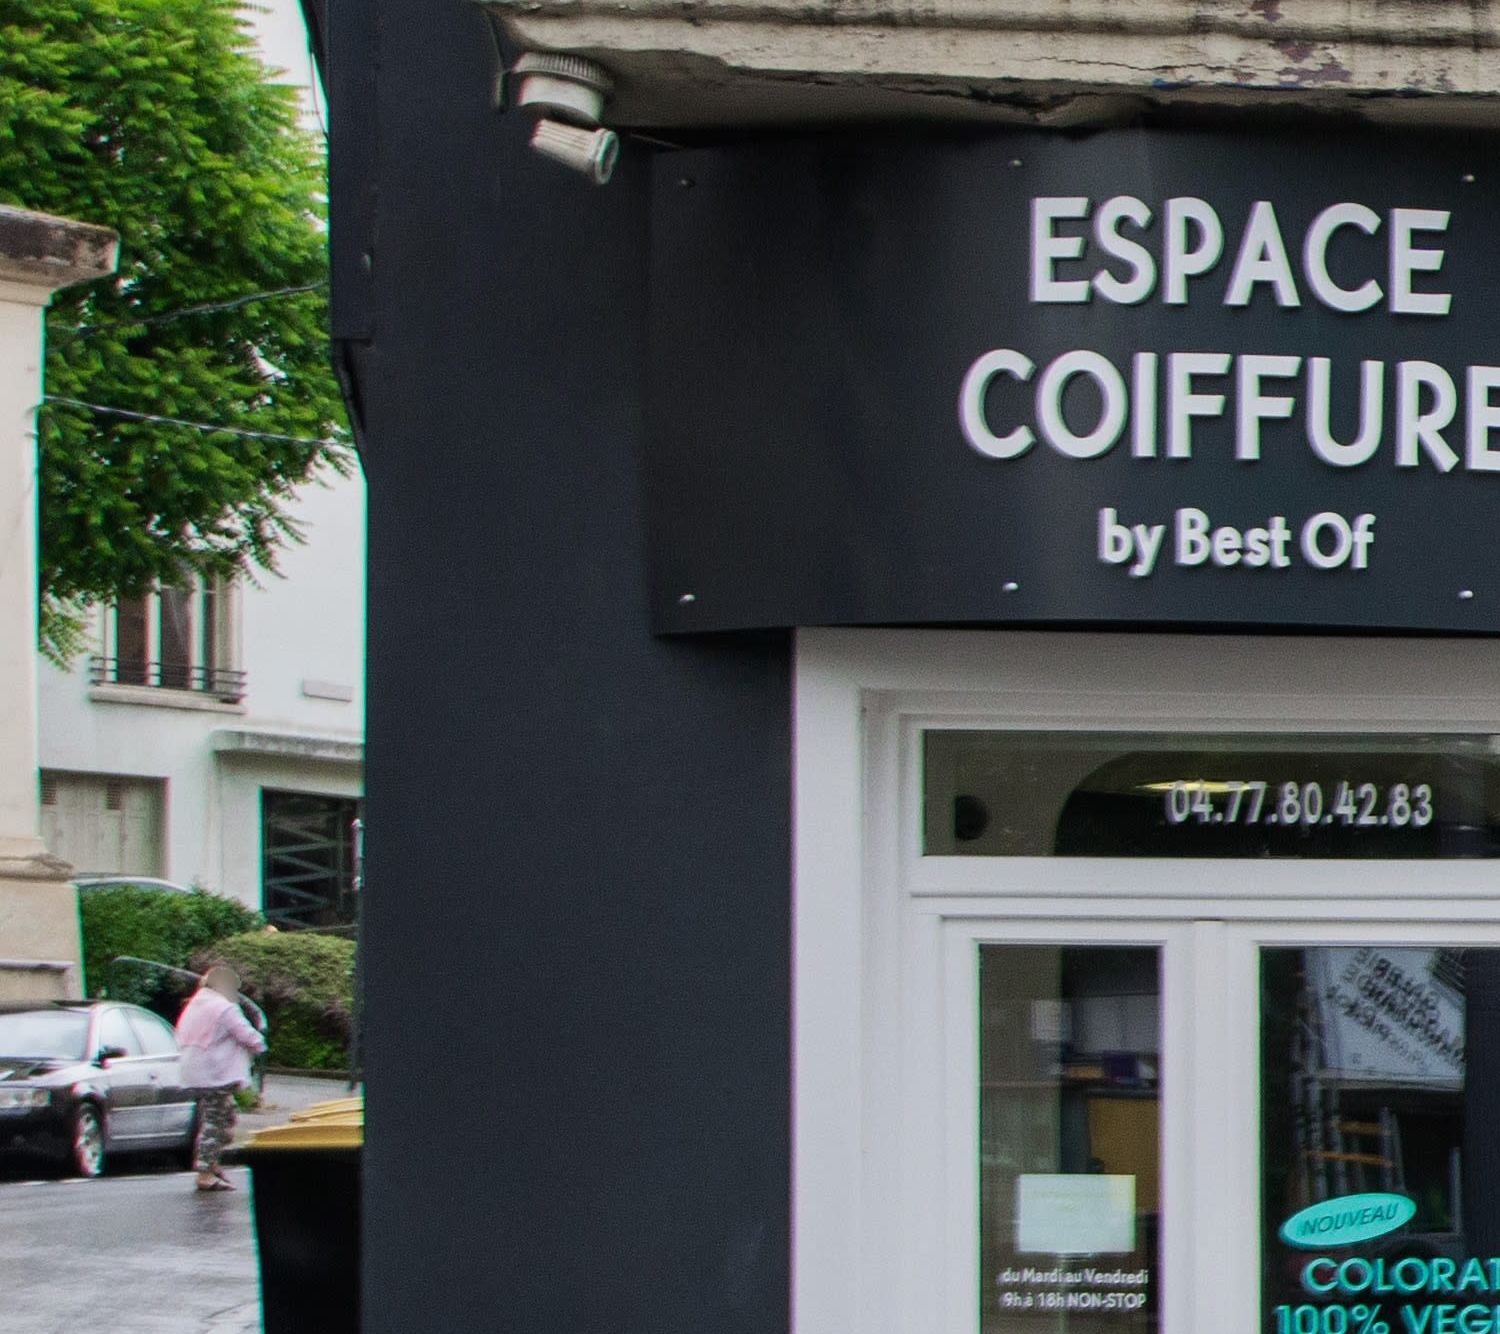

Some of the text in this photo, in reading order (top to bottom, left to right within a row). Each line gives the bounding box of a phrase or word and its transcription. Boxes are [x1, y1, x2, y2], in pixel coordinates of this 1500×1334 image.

[1030, 195, 1452, 315] ESPACE
[1098, 507, 1377, 577] by Best Of
[1166, 778, 1434, 829] 04.77.80.42.83
[1300, 1201, 1400, 1238] NOUVEAU
[1002, 1268, 1149, 1285] du Mardi au Vendredi
[1003, 1292, 1022, 1307] 9h
[1067, 1292, 1147, 1309] NON-STOP
